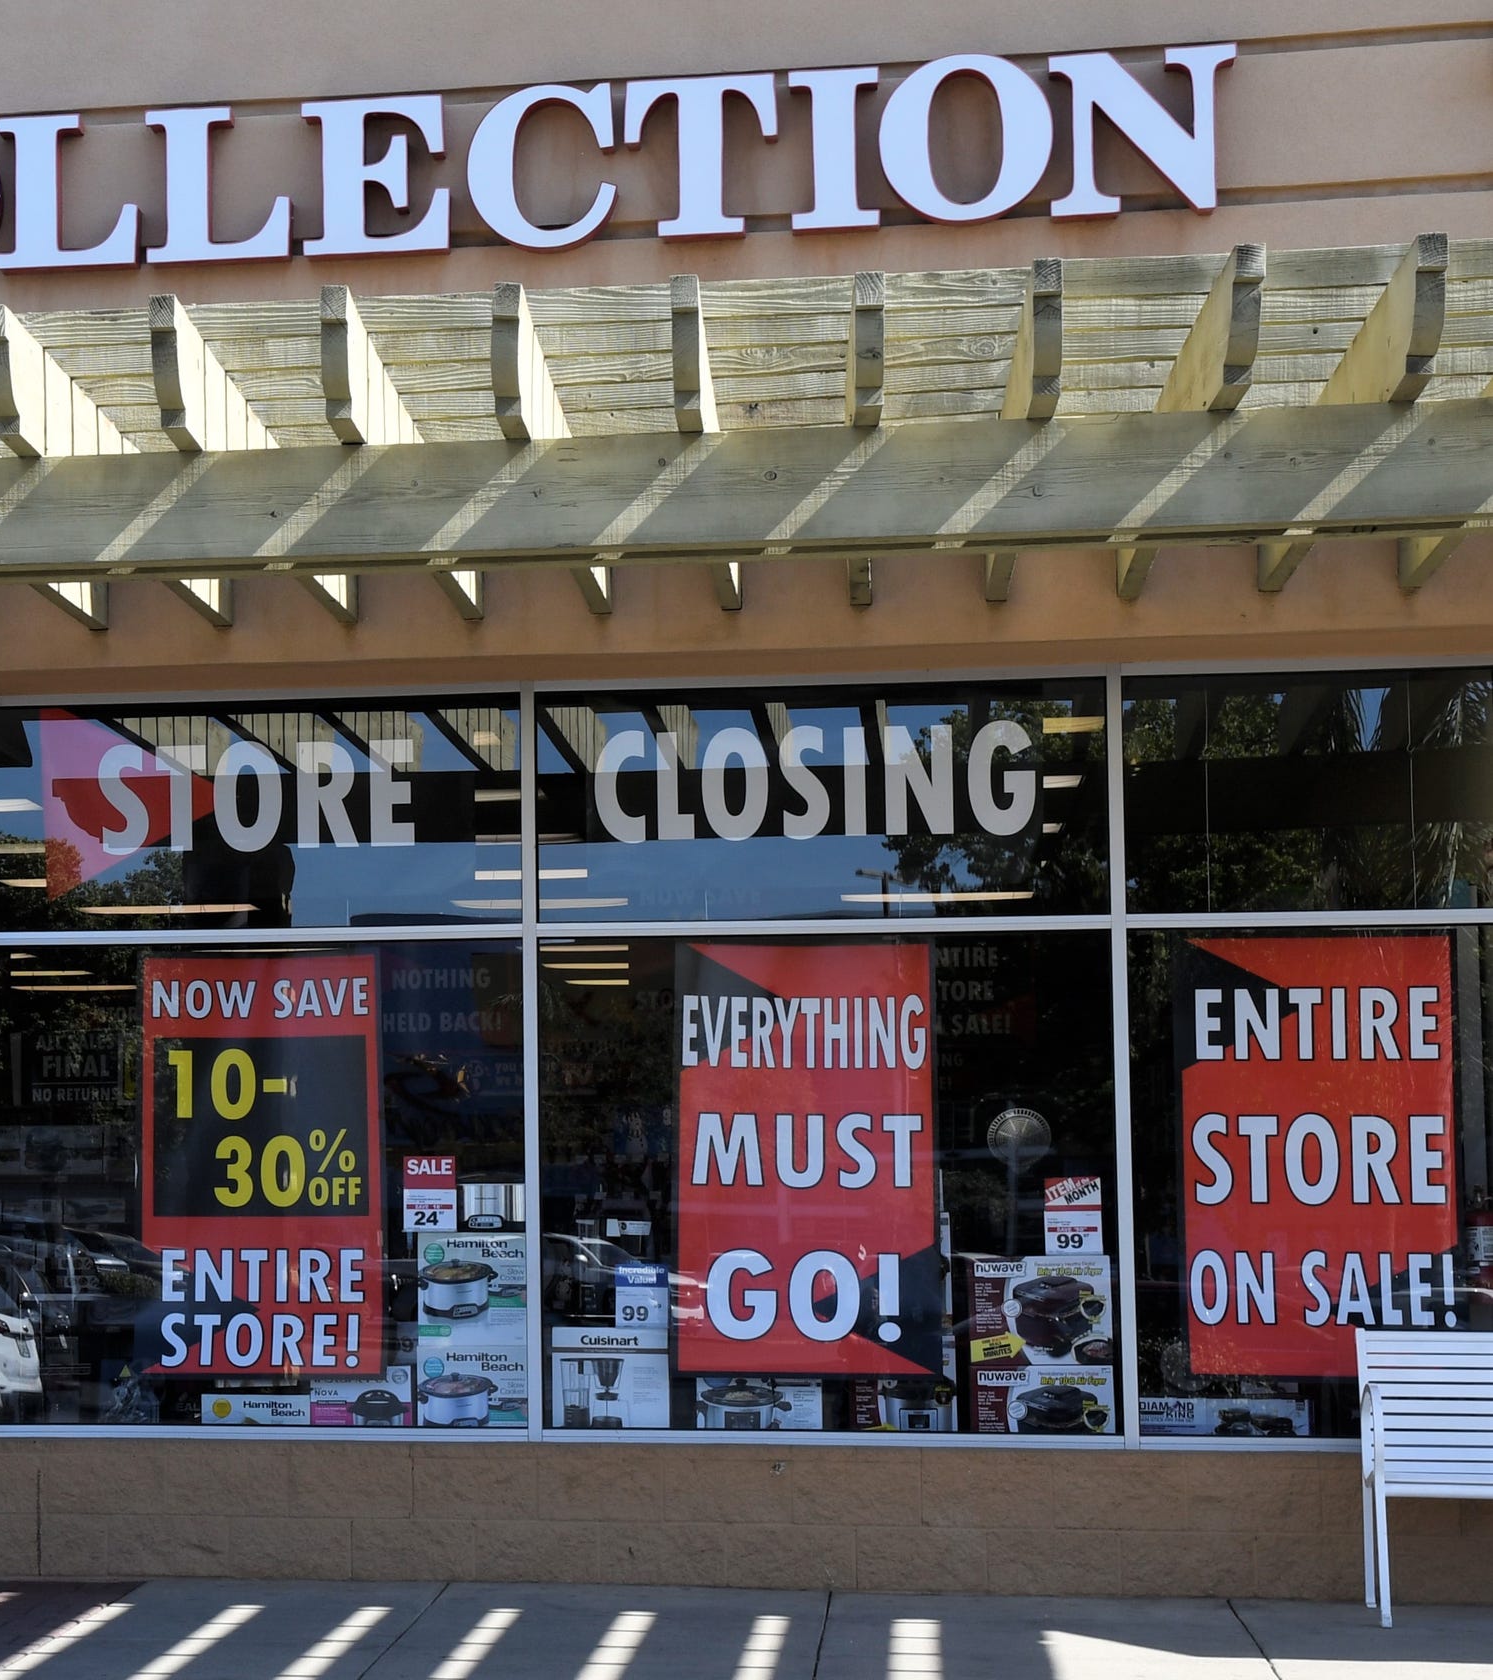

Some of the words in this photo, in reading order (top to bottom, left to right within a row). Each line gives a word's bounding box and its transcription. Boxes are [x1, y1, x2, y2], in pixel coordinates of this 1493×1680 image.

[97, 738, 416, 855] STORE
[594, 720, 1037, 844] CLOSING
[392, 968, 491, 990] NOTHING
[151, 979, 257, 1019] NOW
[273, 977, 370, 1018] SAVE
[938, 980, 995, 1001] TORE
[383, 1012, 431, 1033] HELD
[439, 1011, 502, 1033] BACK!
[681, 993, 928, 1071] EVERYTHING
[1194, 986, 1441, 1062] ENTIRE
[42, 1055, 111, 1078] FINAL
[31, 1087, 52, 1102] NO
[167, 1048, 287, 1120] 10-
[691, 1112, 924, 1190] MUST
[1191, 1112, 1447, 1205] STORE
[406, 1159, 453, 1175] SALE
[308, 1176, 362, 1207] OFF
[1064, 1181, 1100, 1205] MONTH
[414, 1211, 439, 1226] 24
[446, 1239, 508, 1249] Hamilton
[1056, 1233, 1083, 1249] 99
[481, 1249, 524, 1259] Beach
[160, 1247, 365, 1304] ENTIRE
[618, 1265, 665, 1275] Incredible
[976, 1262, 1023, 1273] nuwave
[706, 1248, 904, 1345] GO!
[1189, 1249, 1276, 1325] ON
[1303, 1250, 1459, 1330] SALE!
[158, 1312, 360, 1369] STORE!
[580, 1334, 639, 1347] Cuisinart
[446, 1352, 508, 1362] Hamilton
[481, 1362, 524, 1372] Beach
[979, 1371, 1026, 1381] nuwave
[314, 1389, 339, 1397] NOVA
[243, 1400, 292, 1409] Hamilton
[271, 1408, 305, 1418] Beach
[1166, 1410, 1194, 1418] KING
